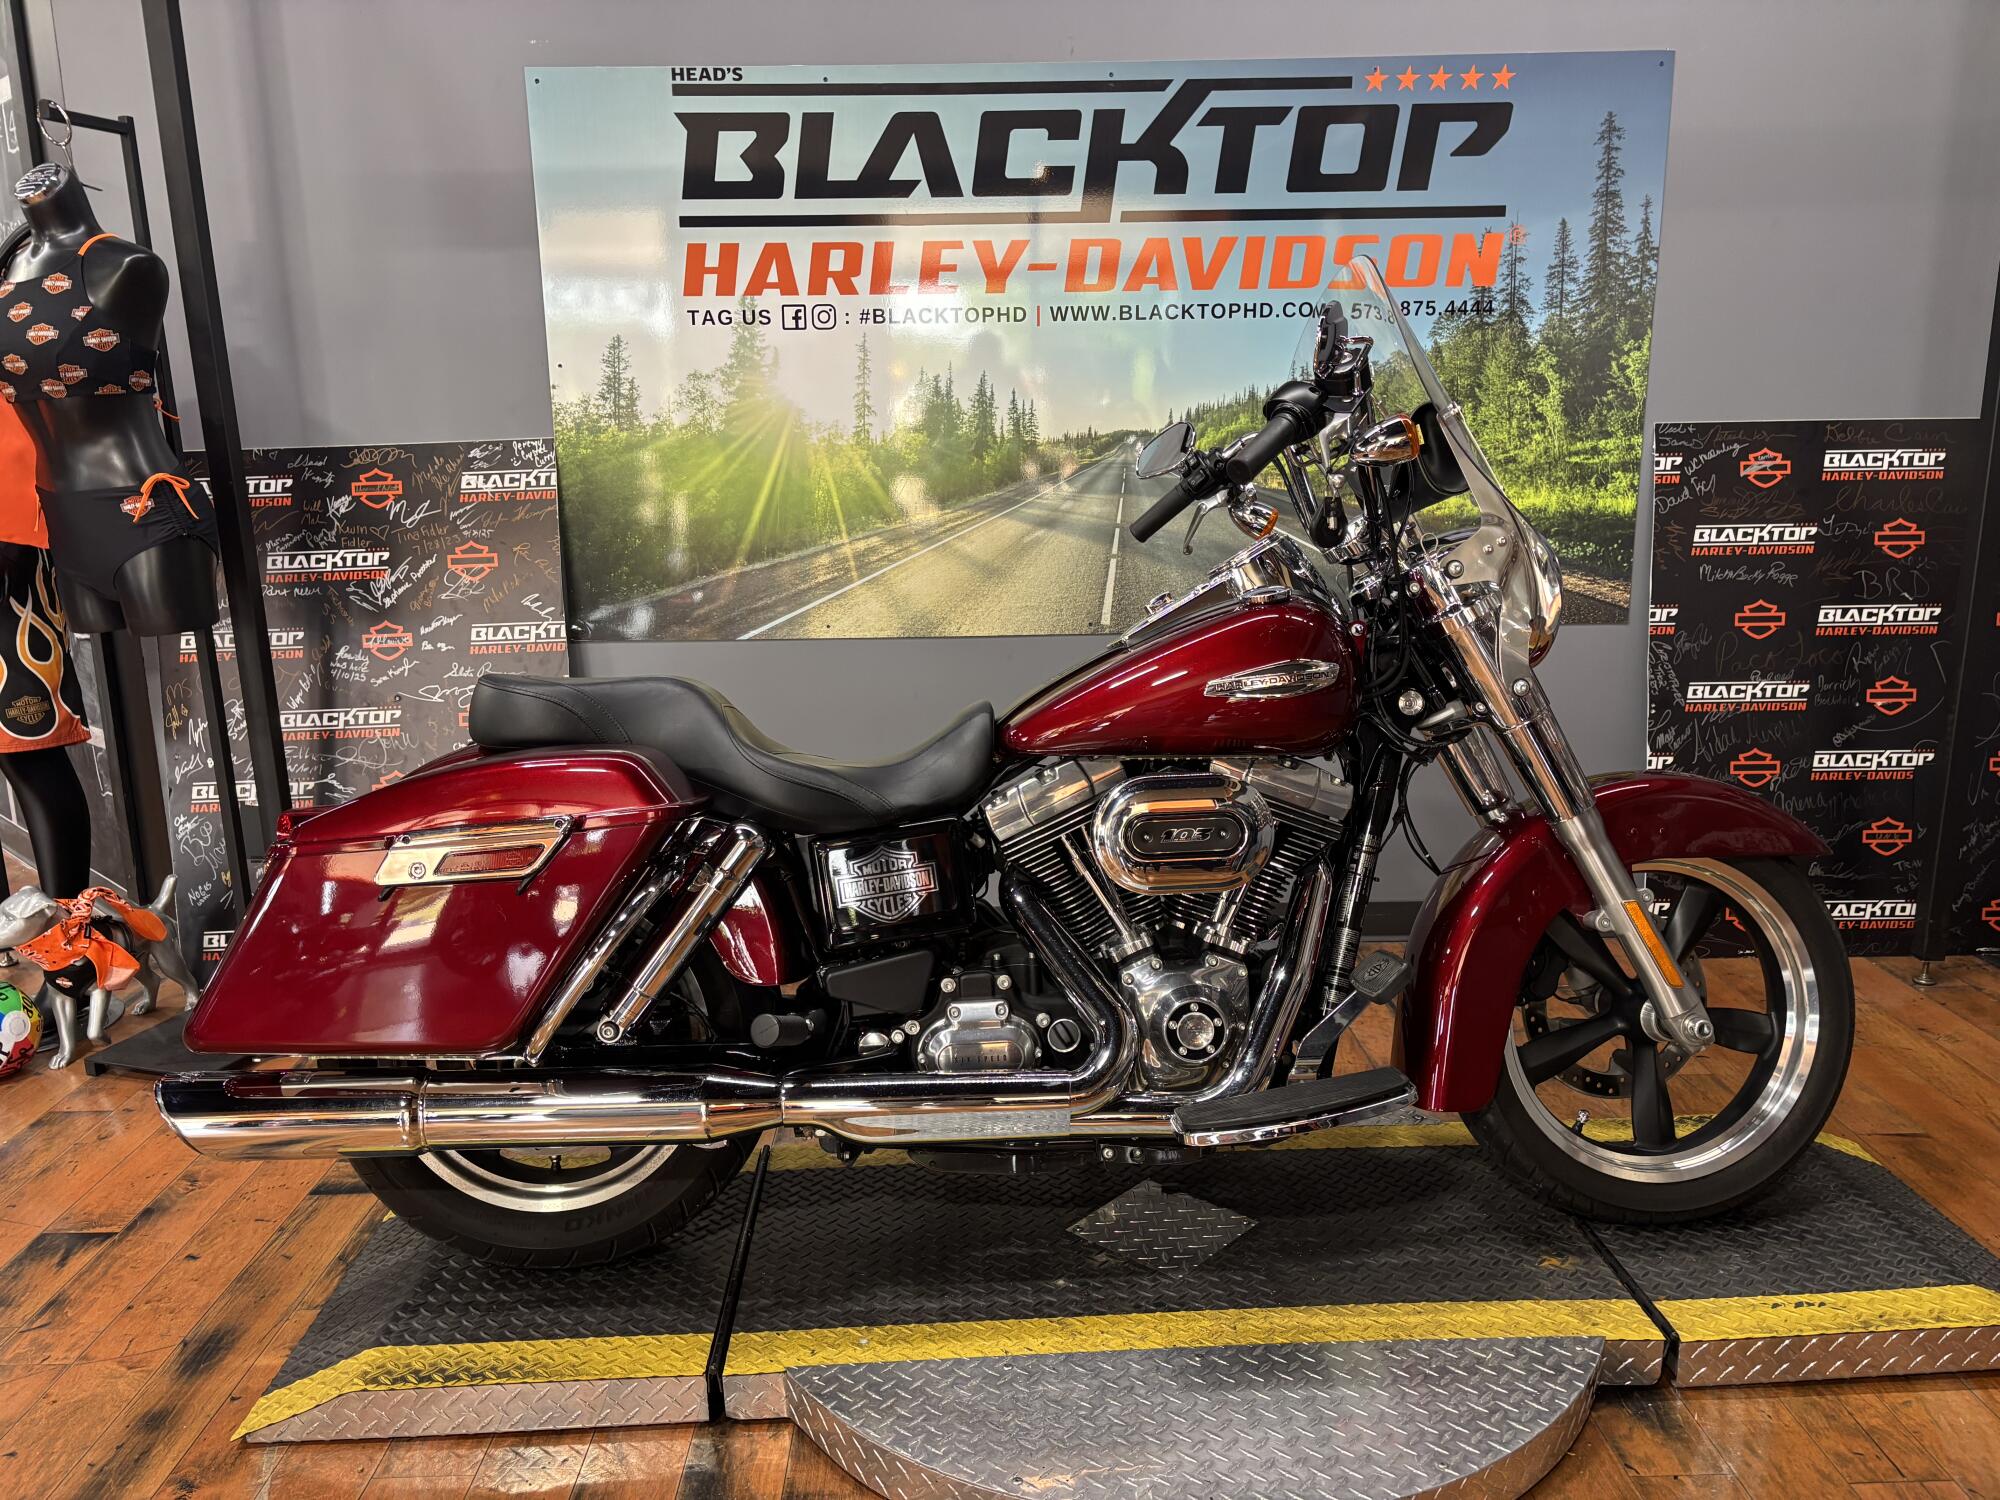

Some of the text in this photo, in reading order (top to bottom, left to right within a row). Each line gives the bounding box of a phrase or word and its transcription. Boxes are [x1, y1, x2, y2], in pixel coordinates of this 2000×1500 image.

[671, 67, 744, 82] HEAD'S
[674, 85, 1513, 217] BLACKTOP
[687, 310, 733, 327] TAG
[747, 309, 772, 326] US
[859, 306, 1028, 326] #BLACKTOPHD
[1823, 449, 1947, 470] BLACKTOP
[1821, 470, 1945, 481] HARLEY-DAVIDSON
[1692, 524, 1818, 545] BLACKTOP
[266, 550, 390, 571] BLACKTOP
[1690, 545, 1816, 556] HARLEY-DAVIDSON
[265, 571, 390, 584] HARLEY-DAVIDSON
[1816, 604, 1942, 625] BLACKTOP
[1815, 625, 1939, 636] HARLEY-DAVIDSON
[1214, 671, 1330, 692] HARLEY-DAVIDSON
[1685, 681, 1811, 702] BLACKTOP
[281, 708, 402, 728] BLACKTOP
[1684, 702, 1808, 713] HARLEY-DAVIDSON
[1811, 750, 1936, 770] BLACKTOP
[862, 858, 914, 875] MOTOR
[843, 870, 930, 900] HARLEY-DAVIDSON
[867, 893, 912, 917] CYCLES
